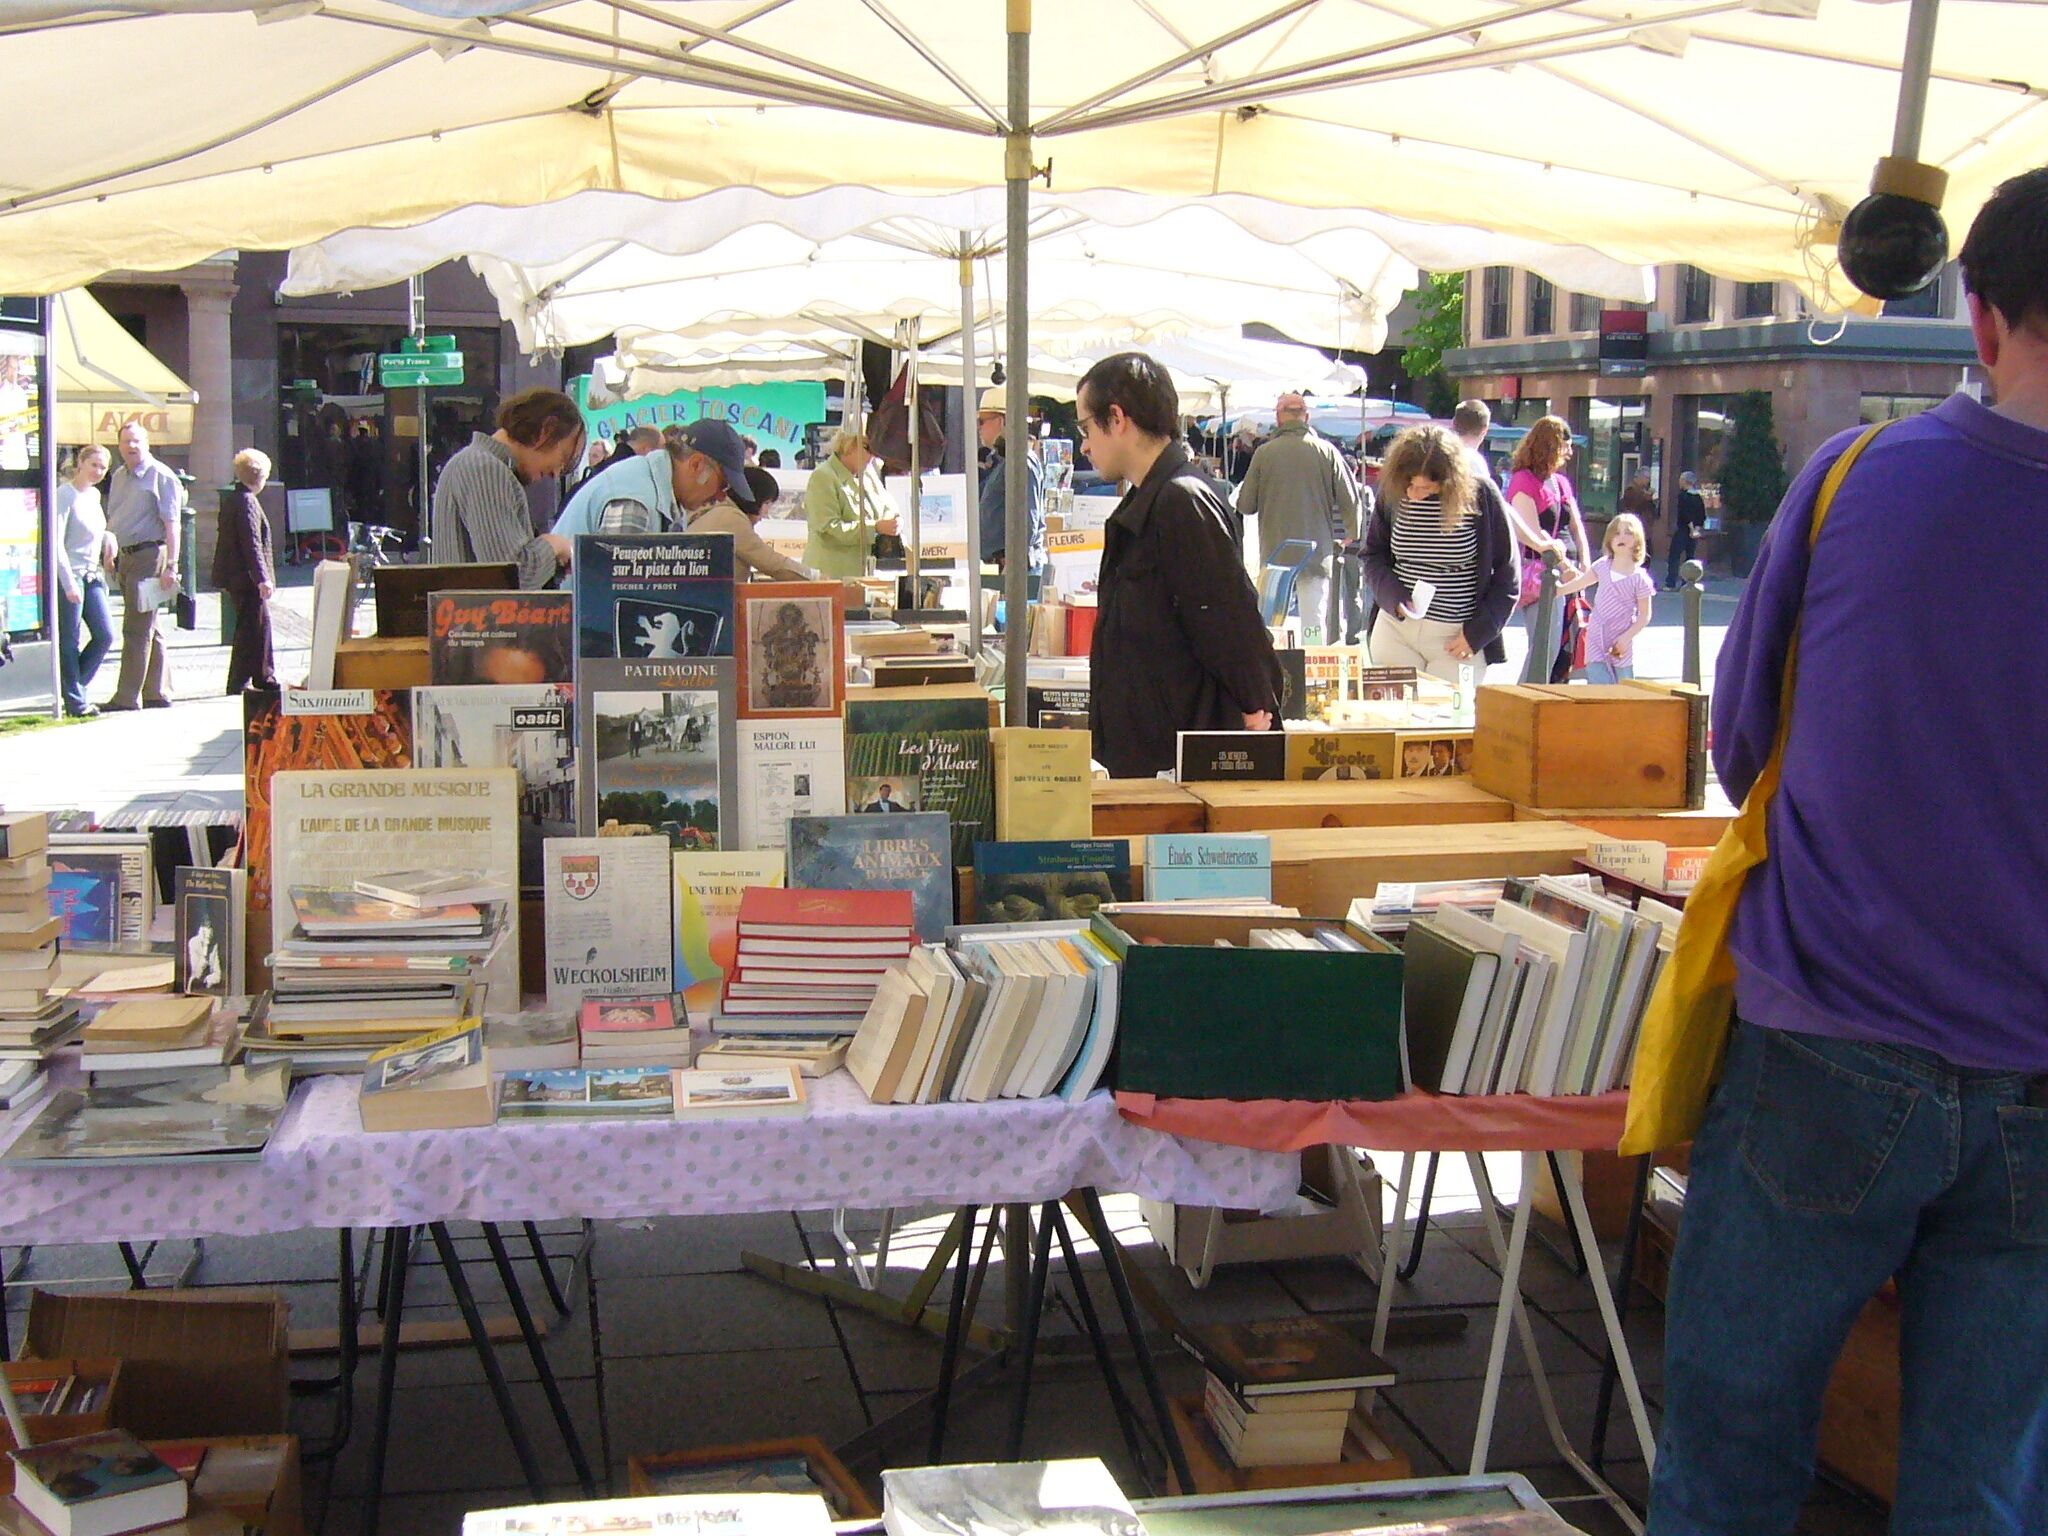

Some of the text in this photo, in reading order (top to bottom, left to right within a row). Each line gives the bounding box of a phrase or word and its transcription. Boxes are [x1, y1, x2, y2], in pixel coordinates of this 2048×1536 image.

[597, 399, 800, 444] GLACIER TOSCANI
[1048, 533, 1085, 547] FLEURS
[612, 545, 653, 563] Peugeot
[655, 545, 705, 560] Mulhouse
[612, 560, 710, 579] sur la piste du lion
[434, 599, 487, 638] Guy
[624, 664, 719, 677] PATRIMOINE
[288, 692, 365, 709] Saxmania!
[515, 711, 561, 725] oasis
[753, 731, 789, 741] ESPION
[799, 740, 817, 750] LUI
[898, 738, 960, 755] Les Vins
[922, 755, 979, 771] d'Alsace
[301, 781, 491, 799] LA GRANDE MUSIQUE
[300, 816, 492, 833] L'AUBE DE LA GRANDE MUSIQUE
[864, 838, 930, 852] LIBRES
[851, 852, 943, 869] ANIMAUX
[1167, 843, 1194, 866] Études
[121, 854, 143, 892] FRANK
[688, 886, 708, 896] UNE
[709, 886, 724, 896] VIE
[725, 886, 738, 896] EN
[553, 967, 667, 985] WECKOLSHEIM
